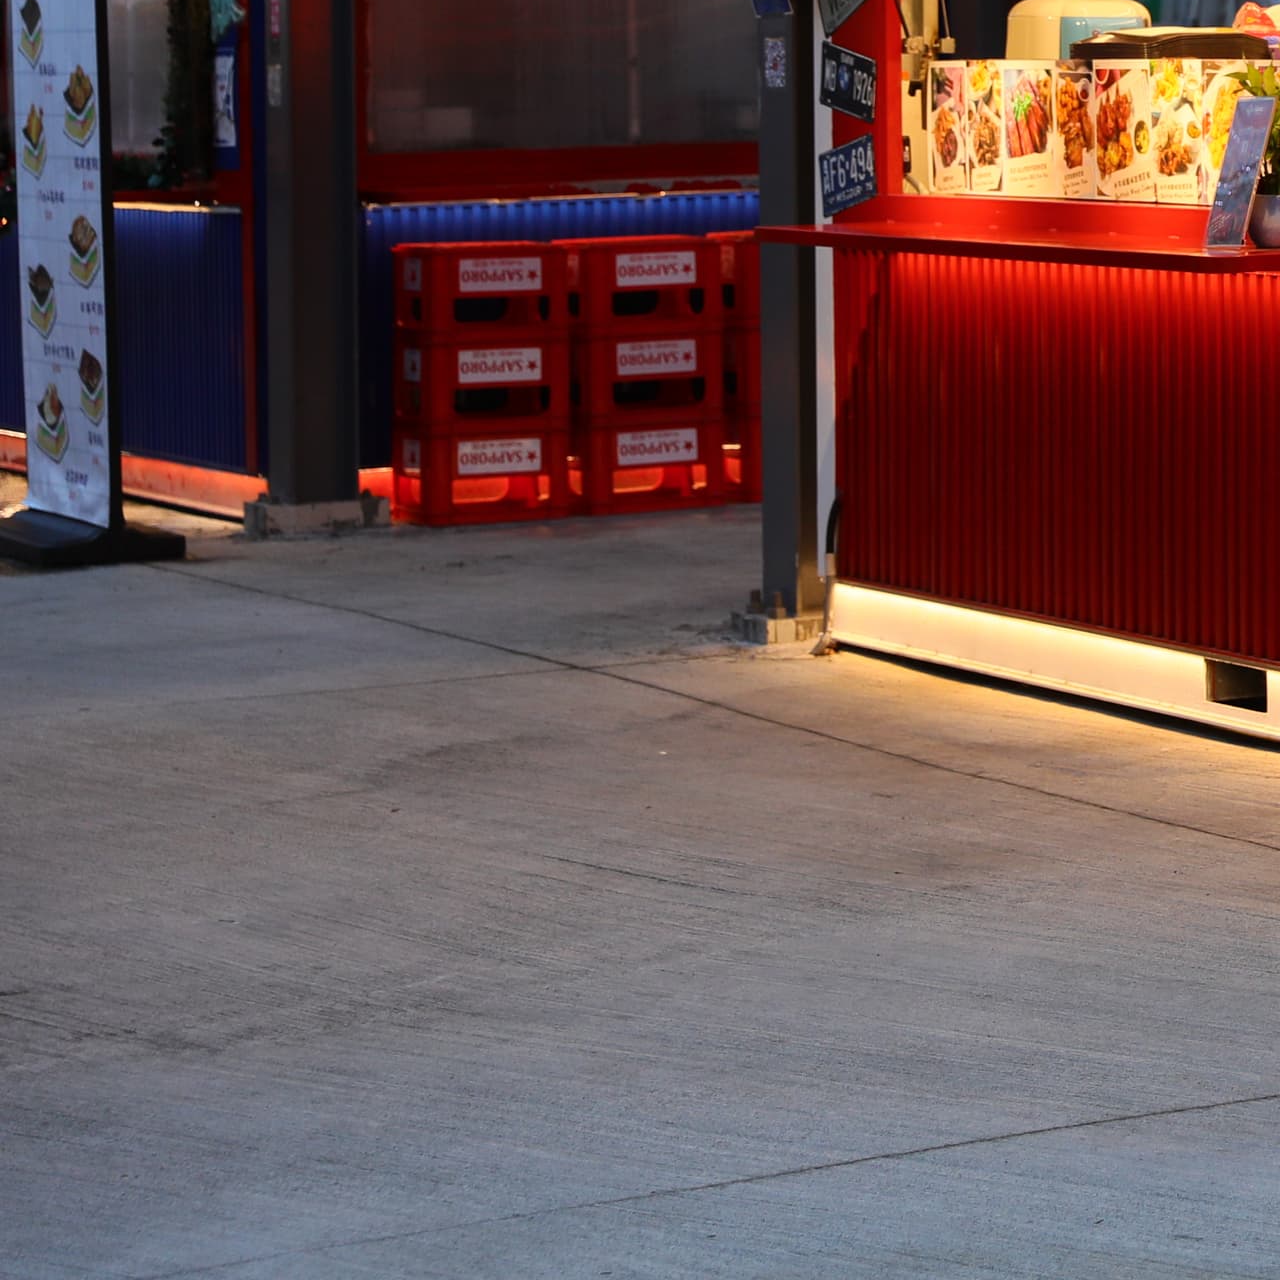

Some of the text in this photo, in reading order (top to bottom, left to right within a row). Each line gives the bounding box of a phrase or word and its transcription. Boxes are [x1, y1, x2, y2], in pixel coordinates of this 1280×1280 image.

[461, 267, 524, 283] SAPPORO
[618, 262, 679, 278] SAPPORO
[460, 359, 523, 375] SAPPORO
[619, 352, 679, 367] SAPPORO
[460, 450, 522, 466] SAPPORO
[620, 442, 680, 458] SAPPORO
